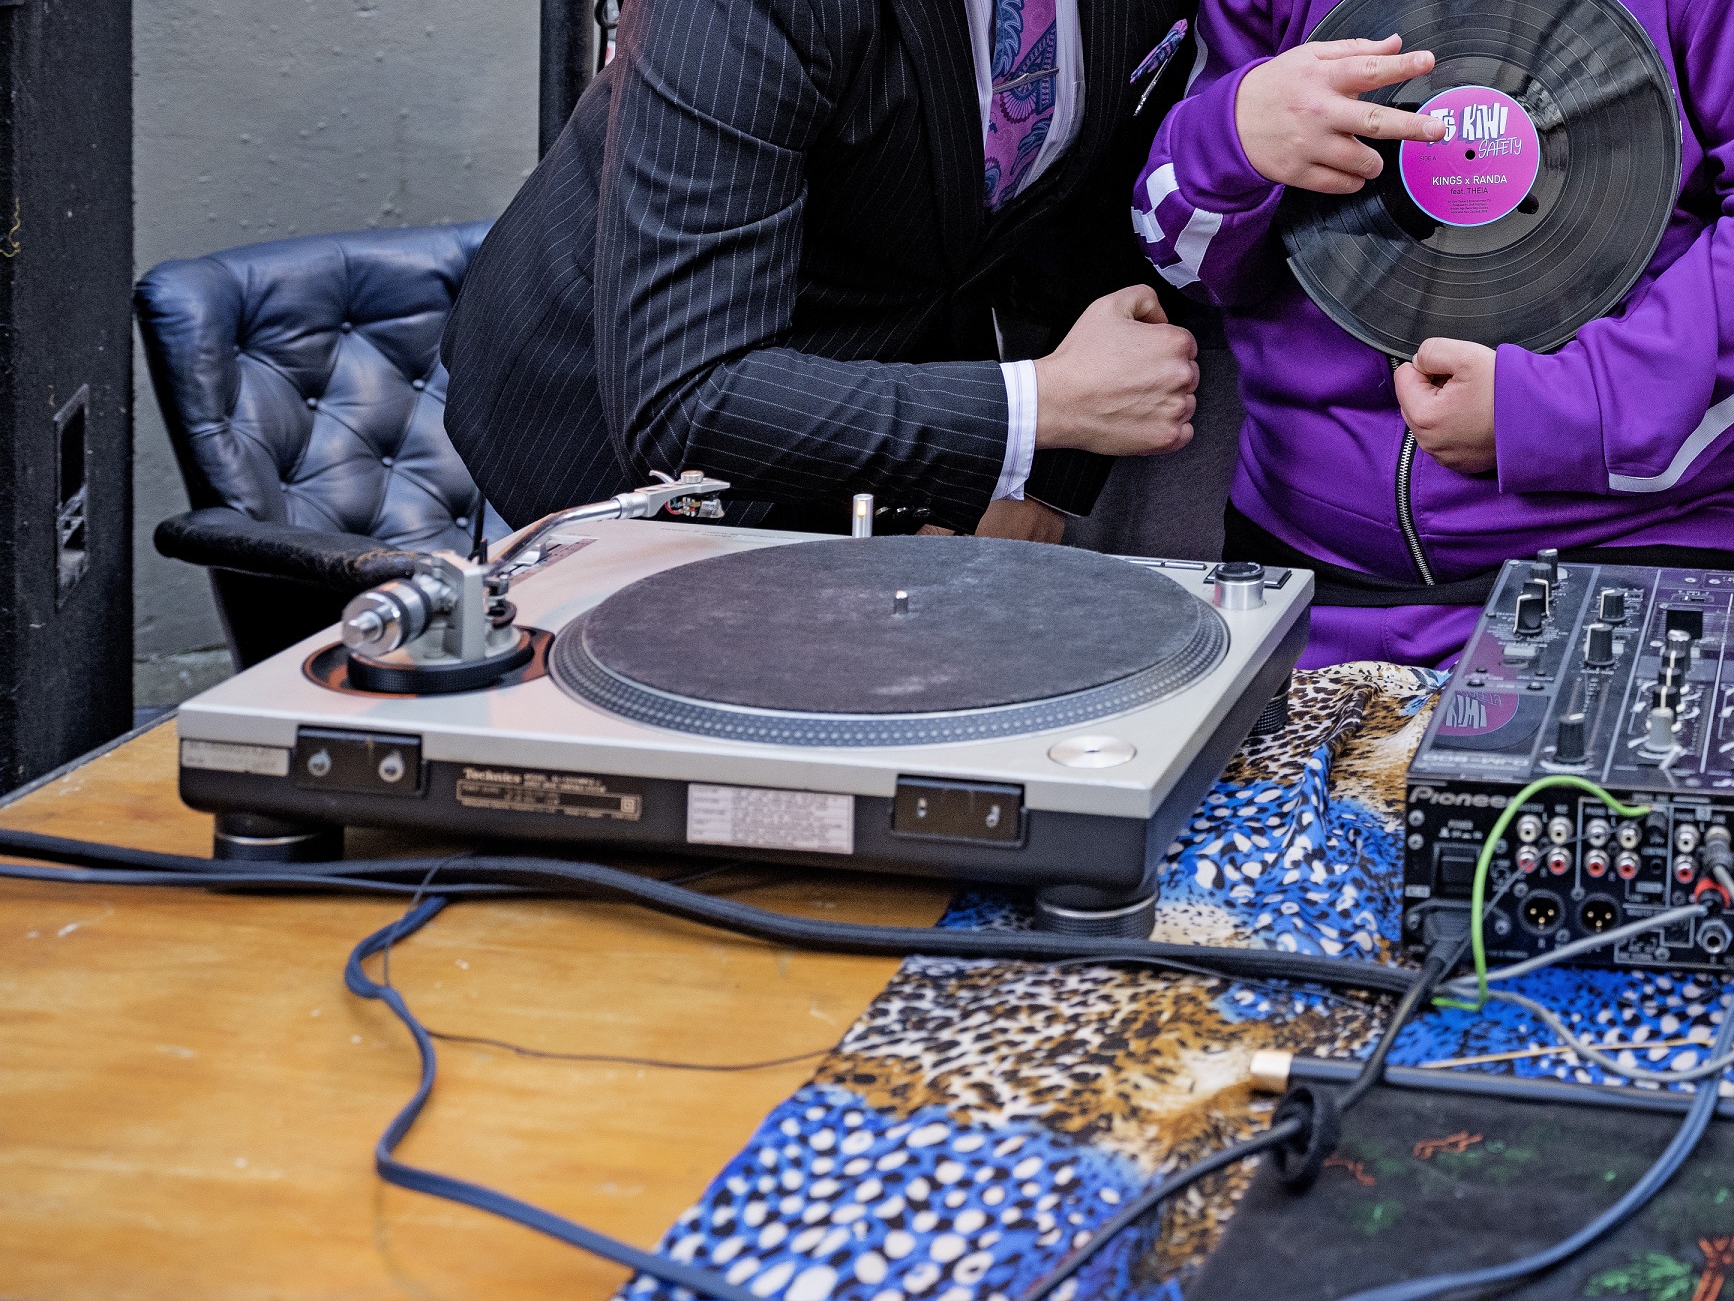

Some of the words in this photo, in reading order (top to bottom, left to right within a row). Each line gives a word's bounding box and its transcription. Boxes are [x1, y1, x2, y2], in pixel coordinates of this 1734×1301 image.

[1462, 102, 1508, 141] KIWI
[1478, 136, 1523, 159] SAFETY
[1432, 176, 1463, 186] KINGS
[1473, 174, 1508, 185] RANDA
